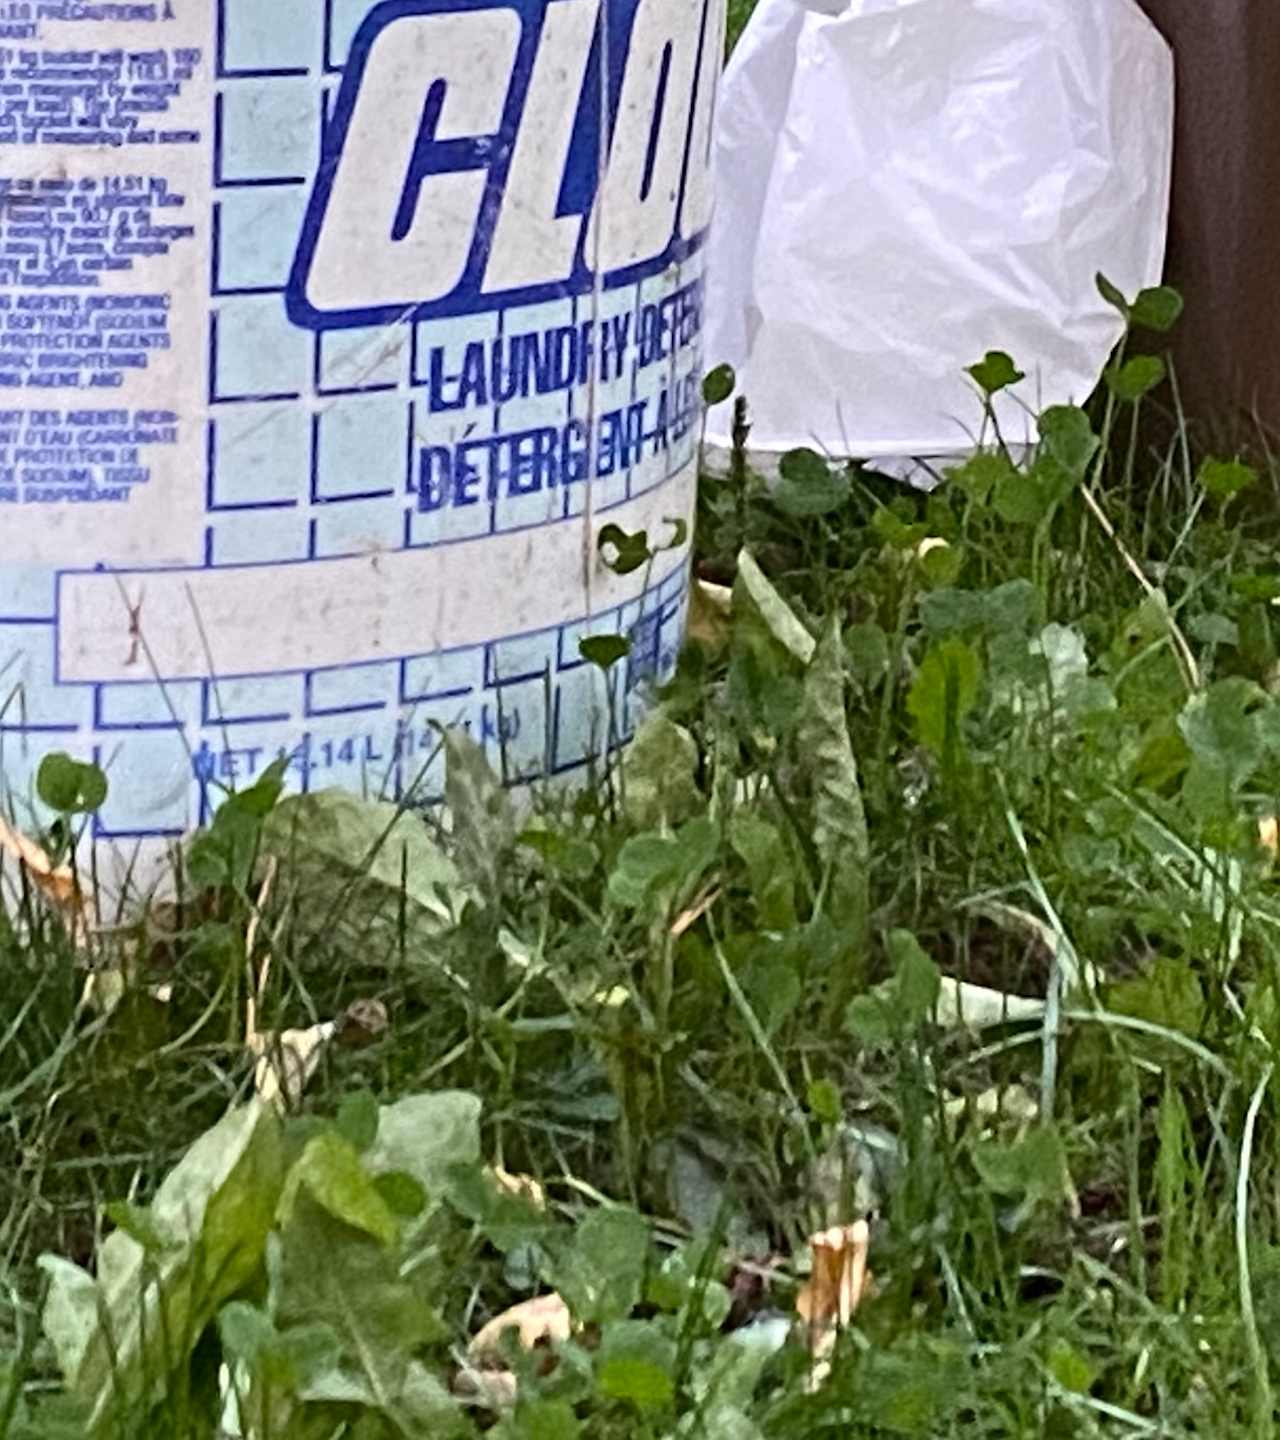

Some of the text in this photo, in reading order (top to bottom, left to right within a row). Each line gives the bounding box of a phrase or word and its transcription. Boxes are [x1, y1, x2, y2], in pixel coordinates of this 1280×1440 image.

[1, 333, 103, 348] PROTECTION
[429, 312, 630, 413] LAUNDRY
[29, 410, 61, 426] DES
[14, 448, 115, 464] PROTECTION
